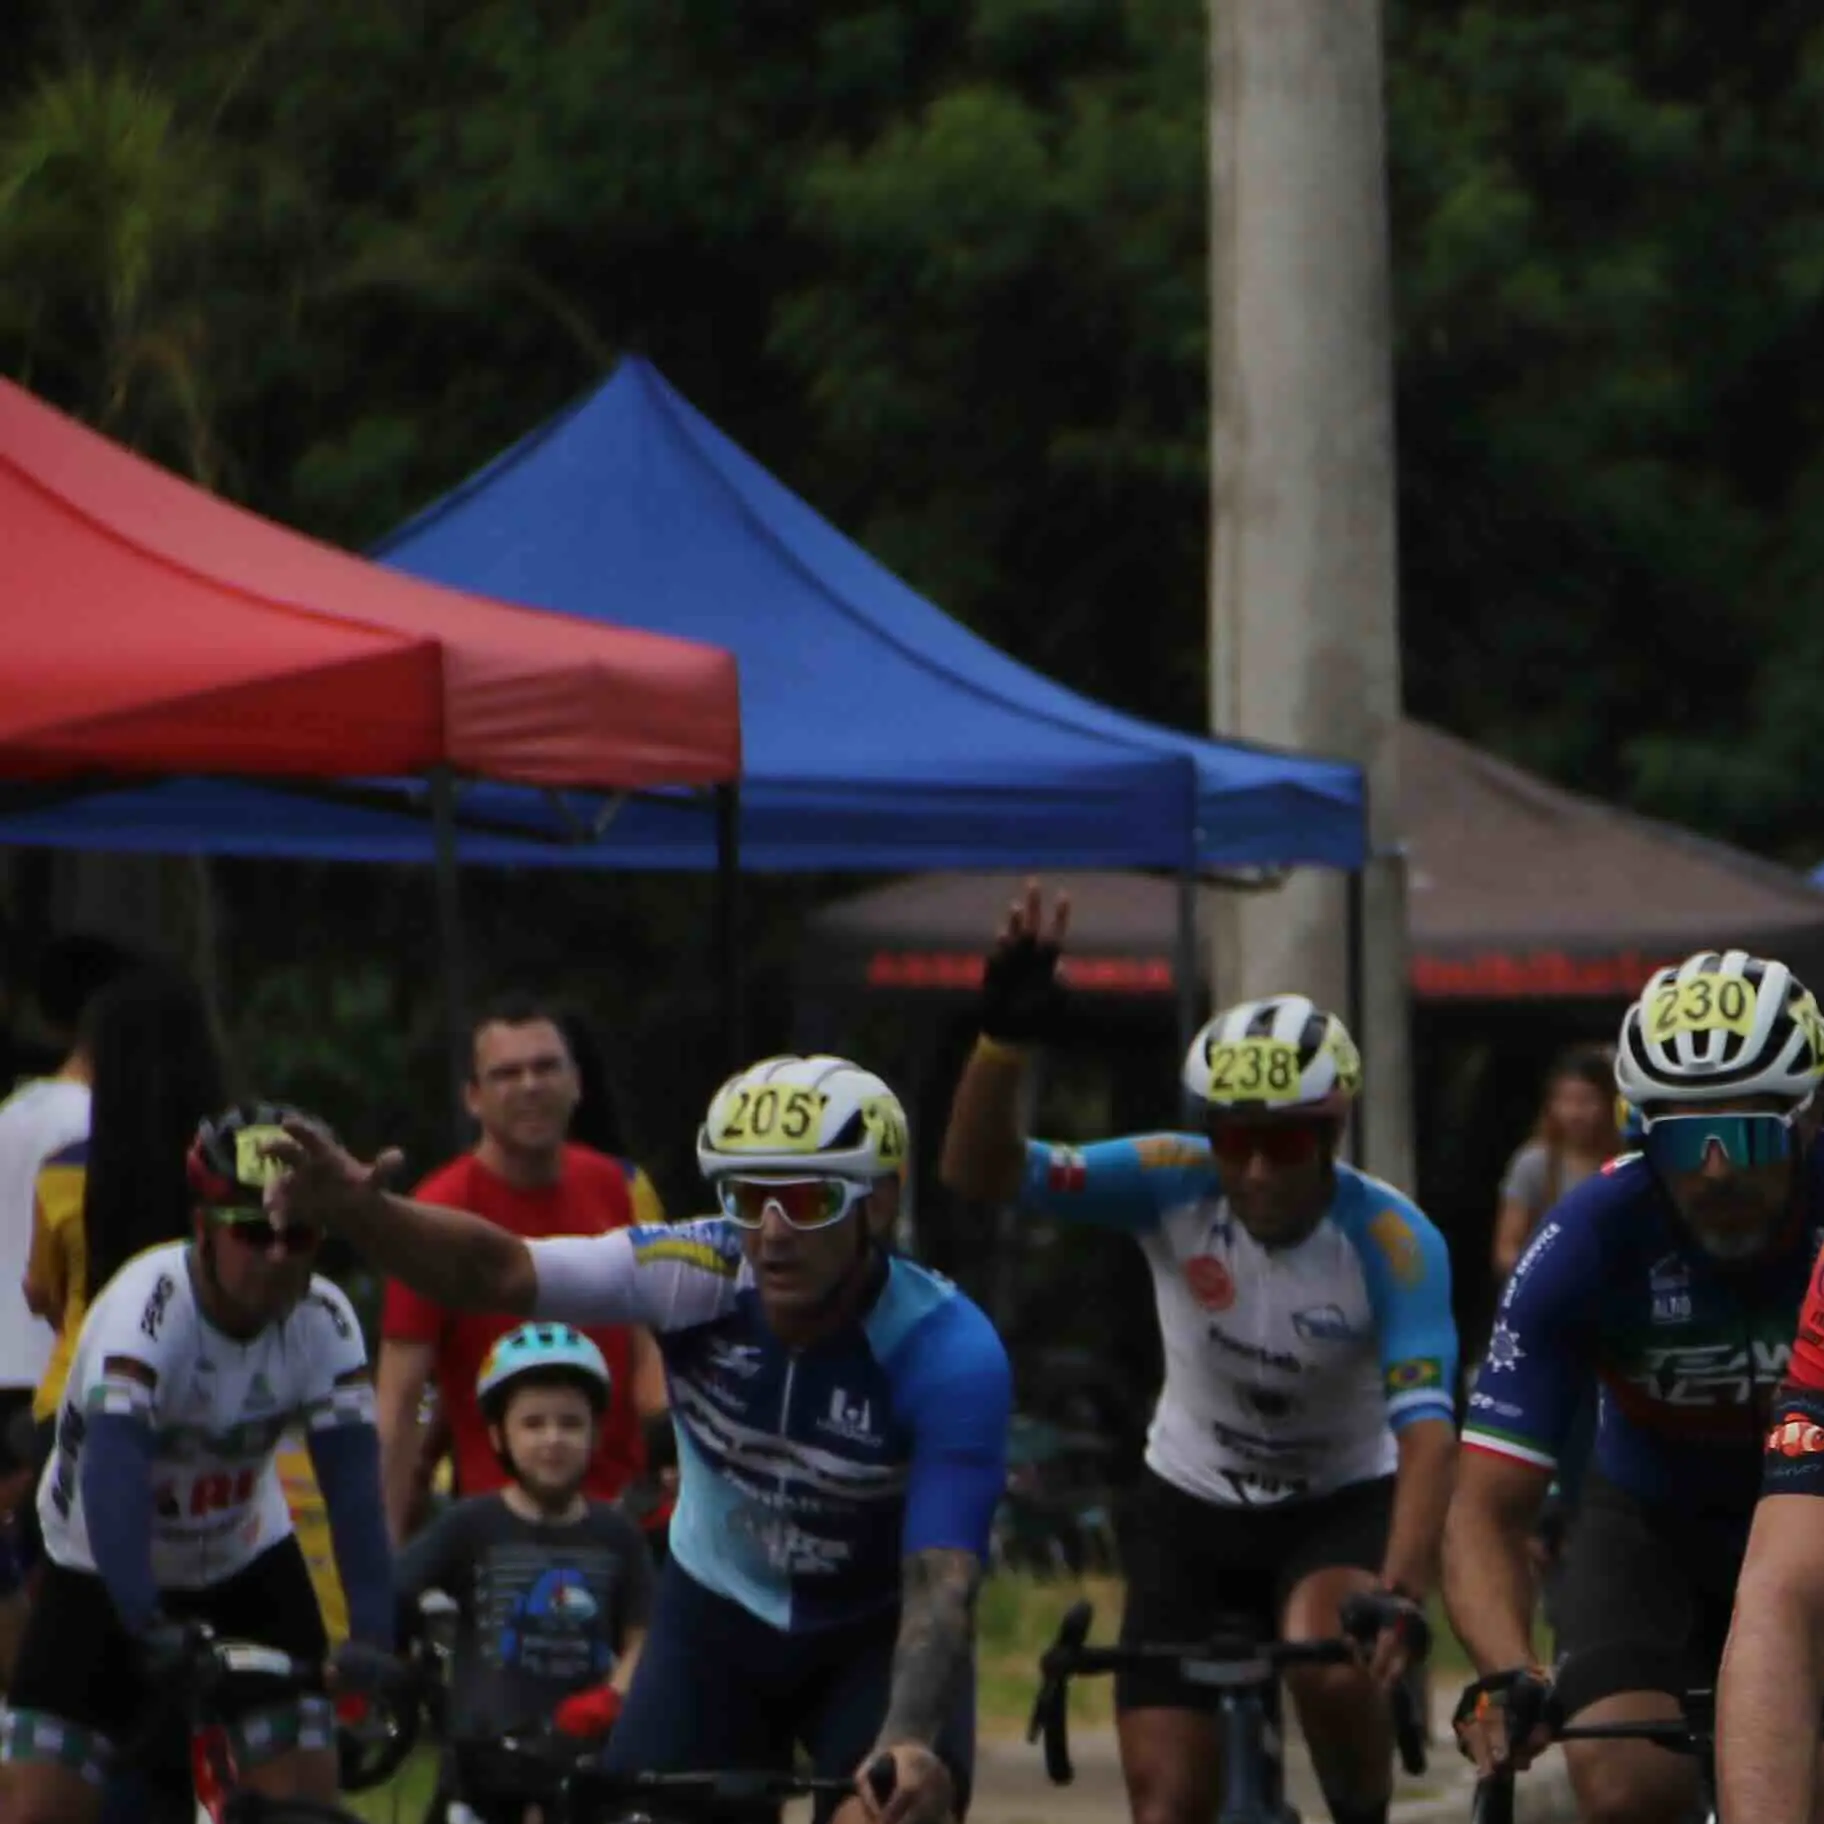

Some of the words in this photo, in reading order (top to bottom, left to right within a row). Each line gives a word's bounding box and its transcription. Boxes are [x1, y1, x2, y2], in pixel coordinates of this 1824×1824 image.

[1656, 980, 1747, 1026] 230
[1211, 1045, 1297, 1091] 238
[722, 1088, 813, 1139] 205
